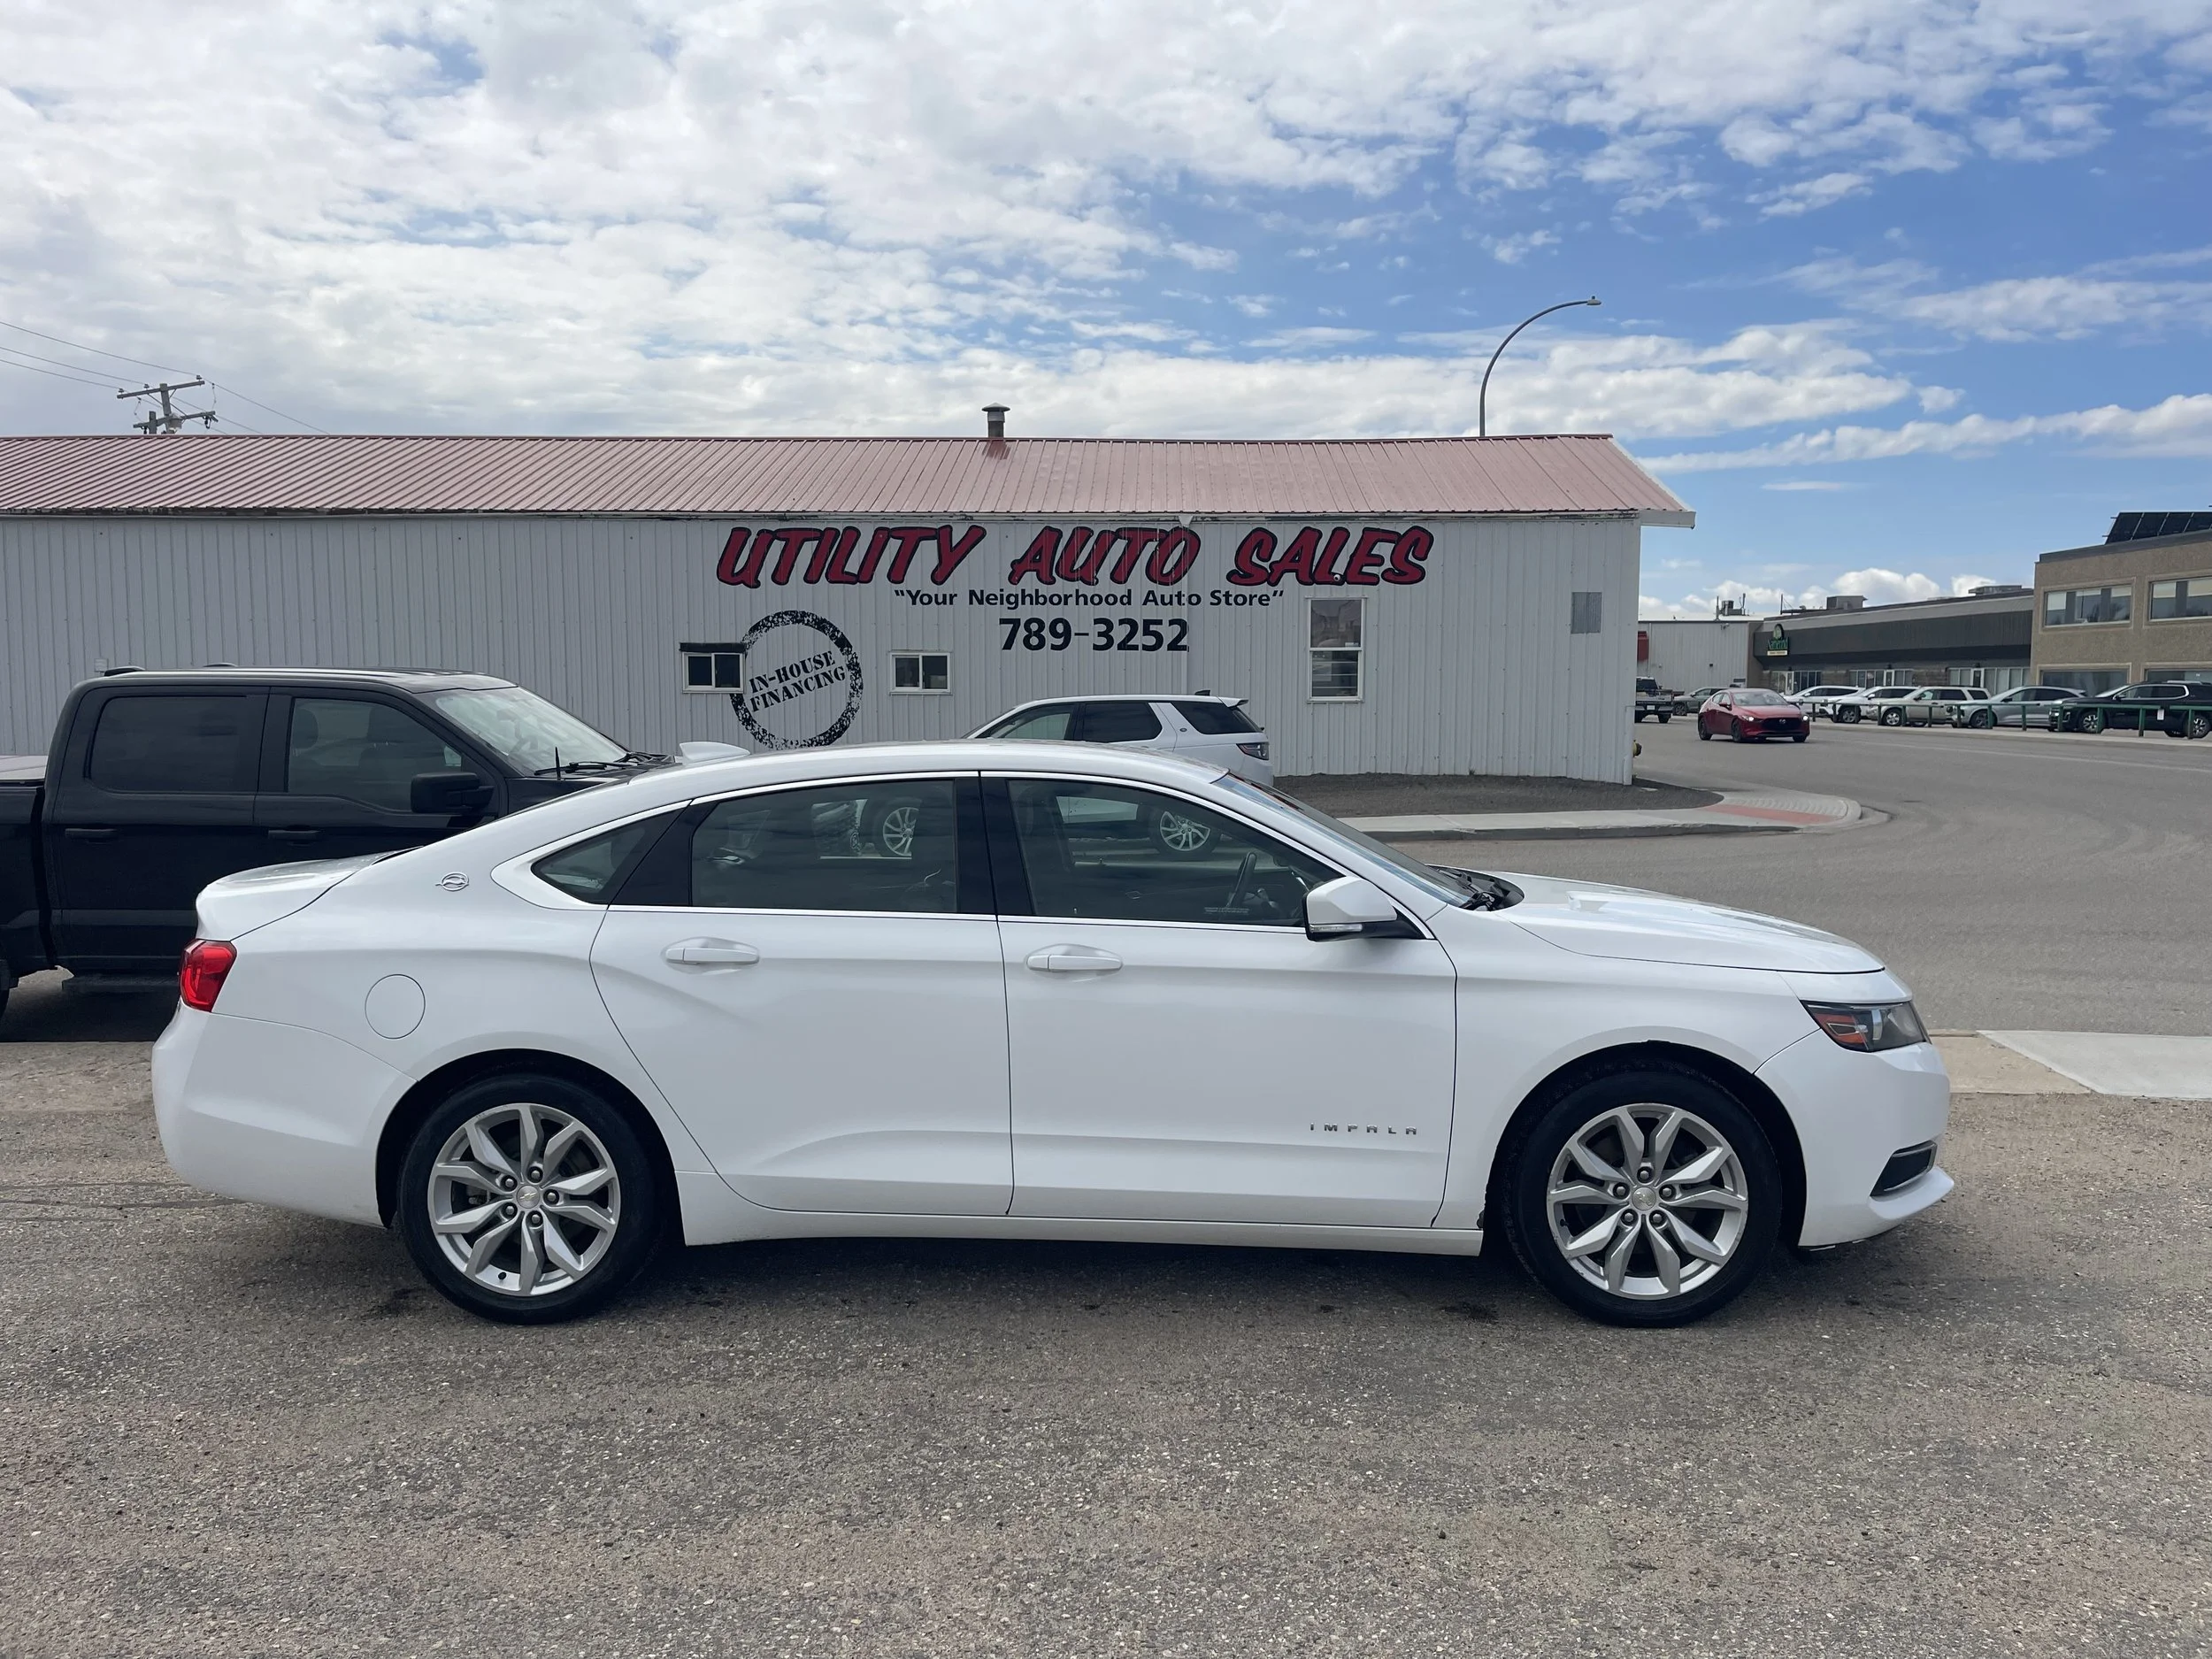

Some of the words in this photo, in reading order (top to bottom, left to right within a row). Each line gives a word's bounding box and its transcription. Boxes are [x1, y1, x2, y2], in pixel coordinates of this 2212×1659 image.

[716, 524, 987, 589] UTILITY
[1007, 525, 1202, 587] AUTO
[1225, 525, 1435, 588] SALES
[968, 588, 1133, 611] Neighborhood
[1141, 588, 1202, 607] Auto
[998, 617, 1190, 653] 789-3252
[749, 650, 835, 694] IN-HOUSE
[749, 665, 846, 712] FINANCING
[1310, 1122, 1417, 1135] IMPALA
